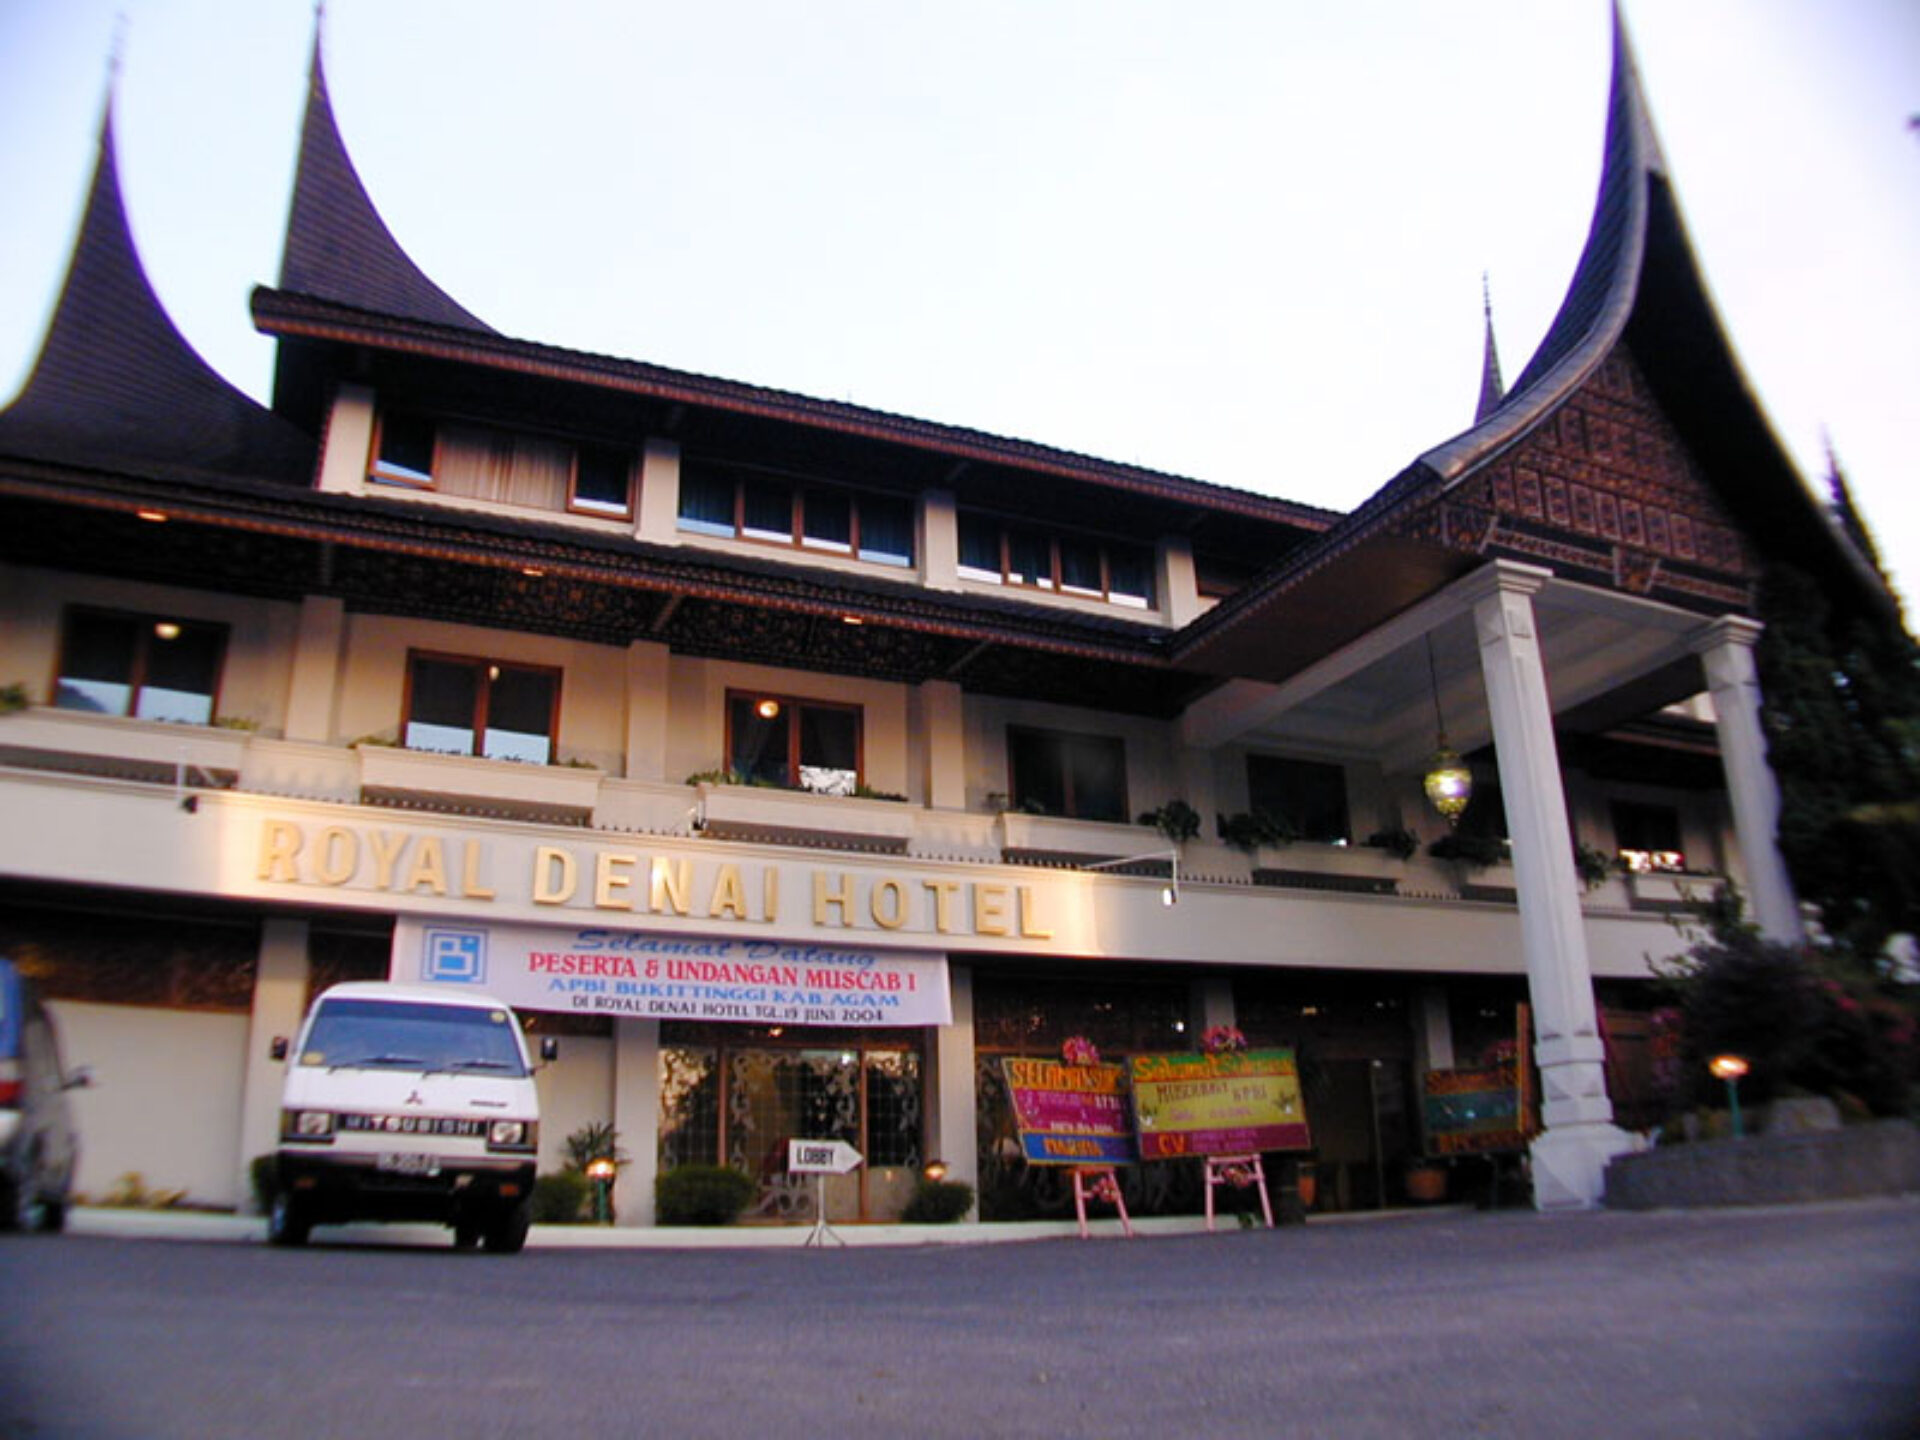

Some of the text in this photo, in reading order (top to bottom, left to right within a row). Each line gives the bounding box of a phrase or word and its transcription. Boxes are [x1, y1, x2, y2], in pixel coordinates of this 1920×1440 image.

[256, 819, 1055, 940] ROYAL DENAI HOTEL
[573, 929, 876, 968] Selamat Datang
[528, 952, 637, 978] PESERTA
[644, 957, 659, 980] &
[666, 958, 798, 986] UNDANGAN
[804, 967, 902, 991] MUSCAB
[549, 978, 606, 993] APBI
[615, 981, 766, 1001] BUKITTINGGI
[830, 993, 900, 1007] AGAM
[572, 995, 589, 1009] DI
[595, 996, 642, 1012] ROYAL
[650, 999, 697, 1015] DENAI
[703, 1002, 749, 1017] HOTEL
[804, 1007, 836, 1022] JUNI
[842, 1009, 884, 1022] 2004
[344, 1114, 480, 1137] MITSUBISHI
[796, 1146, 834, 1166] LOBBY
